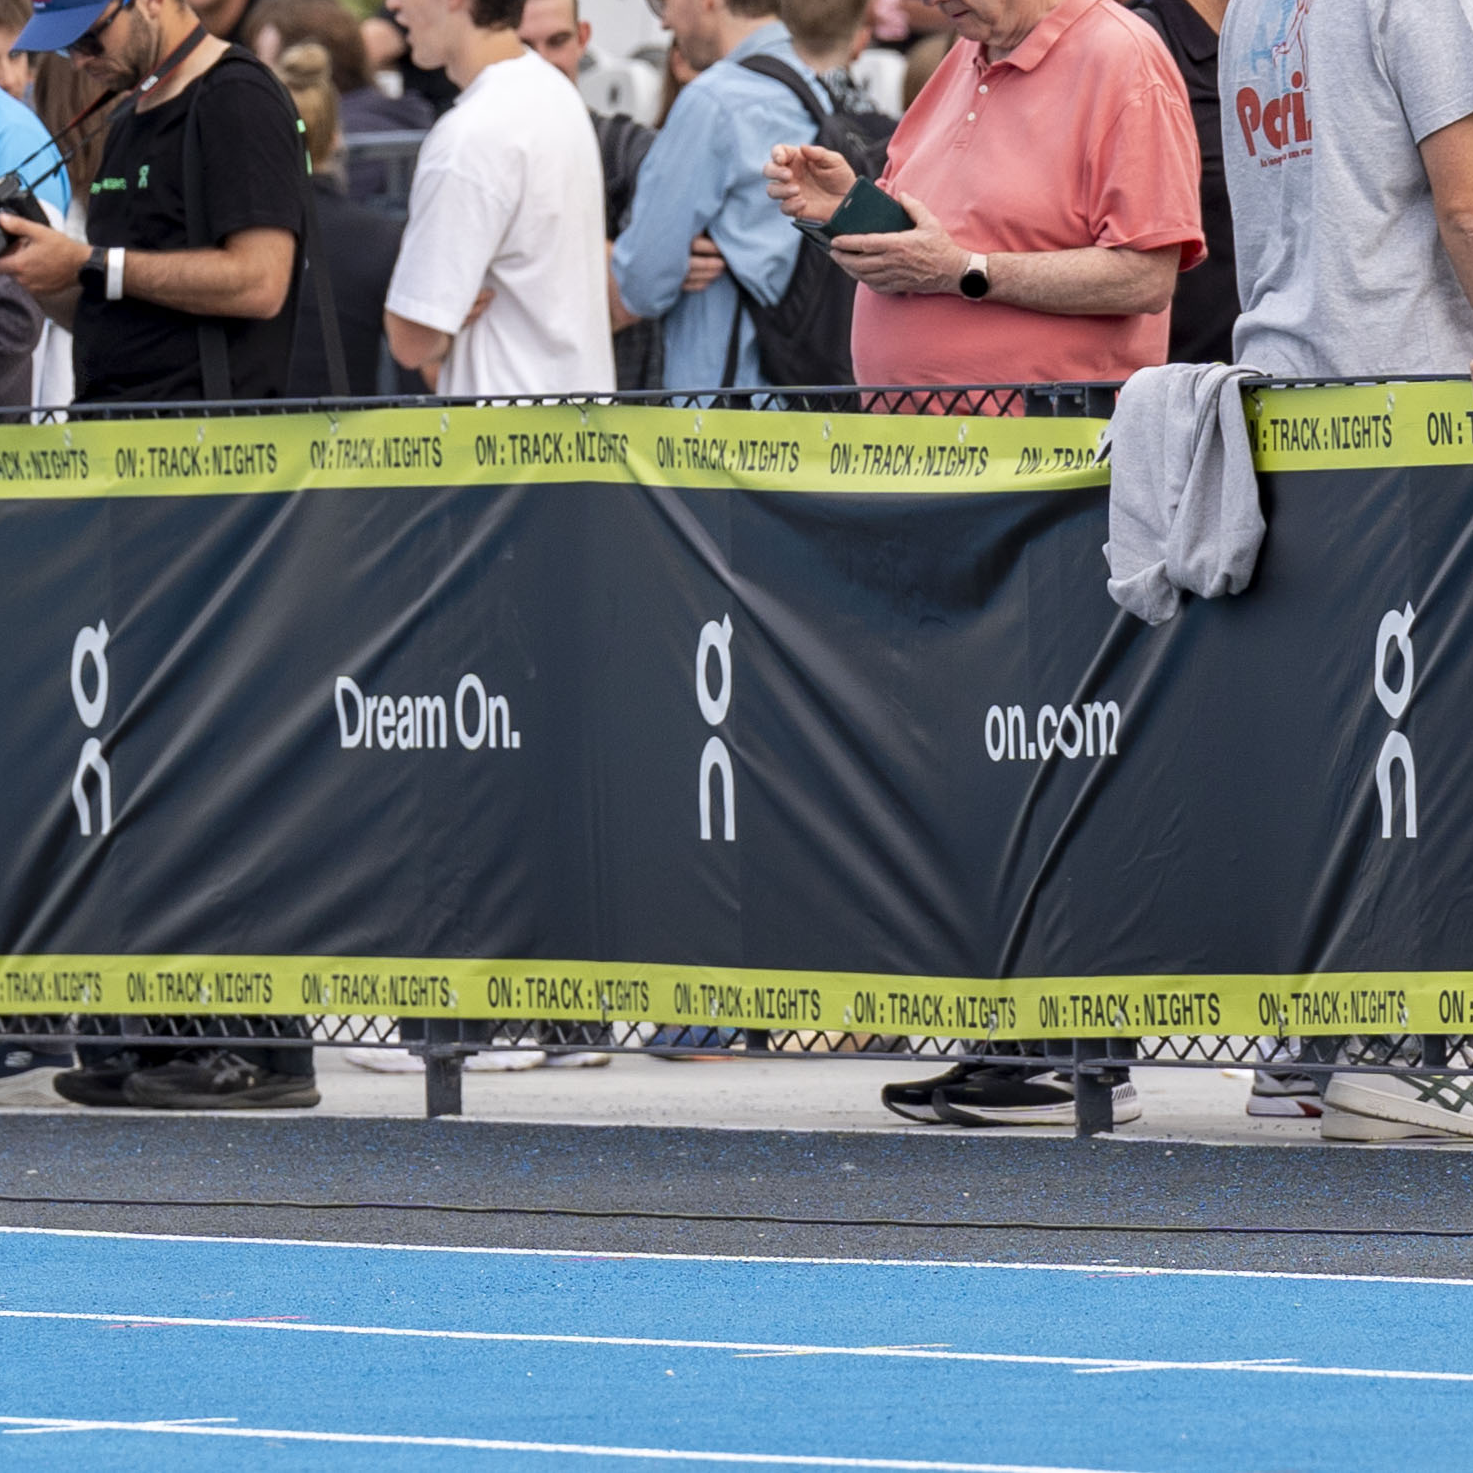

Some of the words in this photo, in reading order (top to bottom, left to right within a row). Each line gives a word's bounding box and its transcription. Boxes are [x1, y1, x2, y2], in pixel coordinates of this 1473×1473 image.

[115, 443, 278, 479] ON:TRACK:NIGHTS
[310, 436, 443, 469] ON:TRACK:NIGHTS
[475, 430, 629, 466] ON:TRACK:NIGHTS
[656, 435, 800, 473] ON:TRACK:NIGHTS
[830, 441, 989, 477] ON:TRACK:NIGHTS
[334, 675, 448, 751] Dream
[455, 673, 521, 751] On.
[985, 699, 1121, 762] on.com
[127, 971, 273, 1004] ON:TRACK:NIGHTS
[301, 973, 450, 1007] ON:TRACK:NIGHTS
[488, 976, 650, 1013] ON:TRACK:NIGHTS
[674, 983, 822, 1021] ON:TRACK:NIGHTS
[854, 990, 1017, 1029] ON:TRACK:NIGHTS
[1040, 992, 1221, 1027] ON:TRACK:NIGHTS
[1259, 990, 1406, 1027] ON:TRACK:NIGHTS
